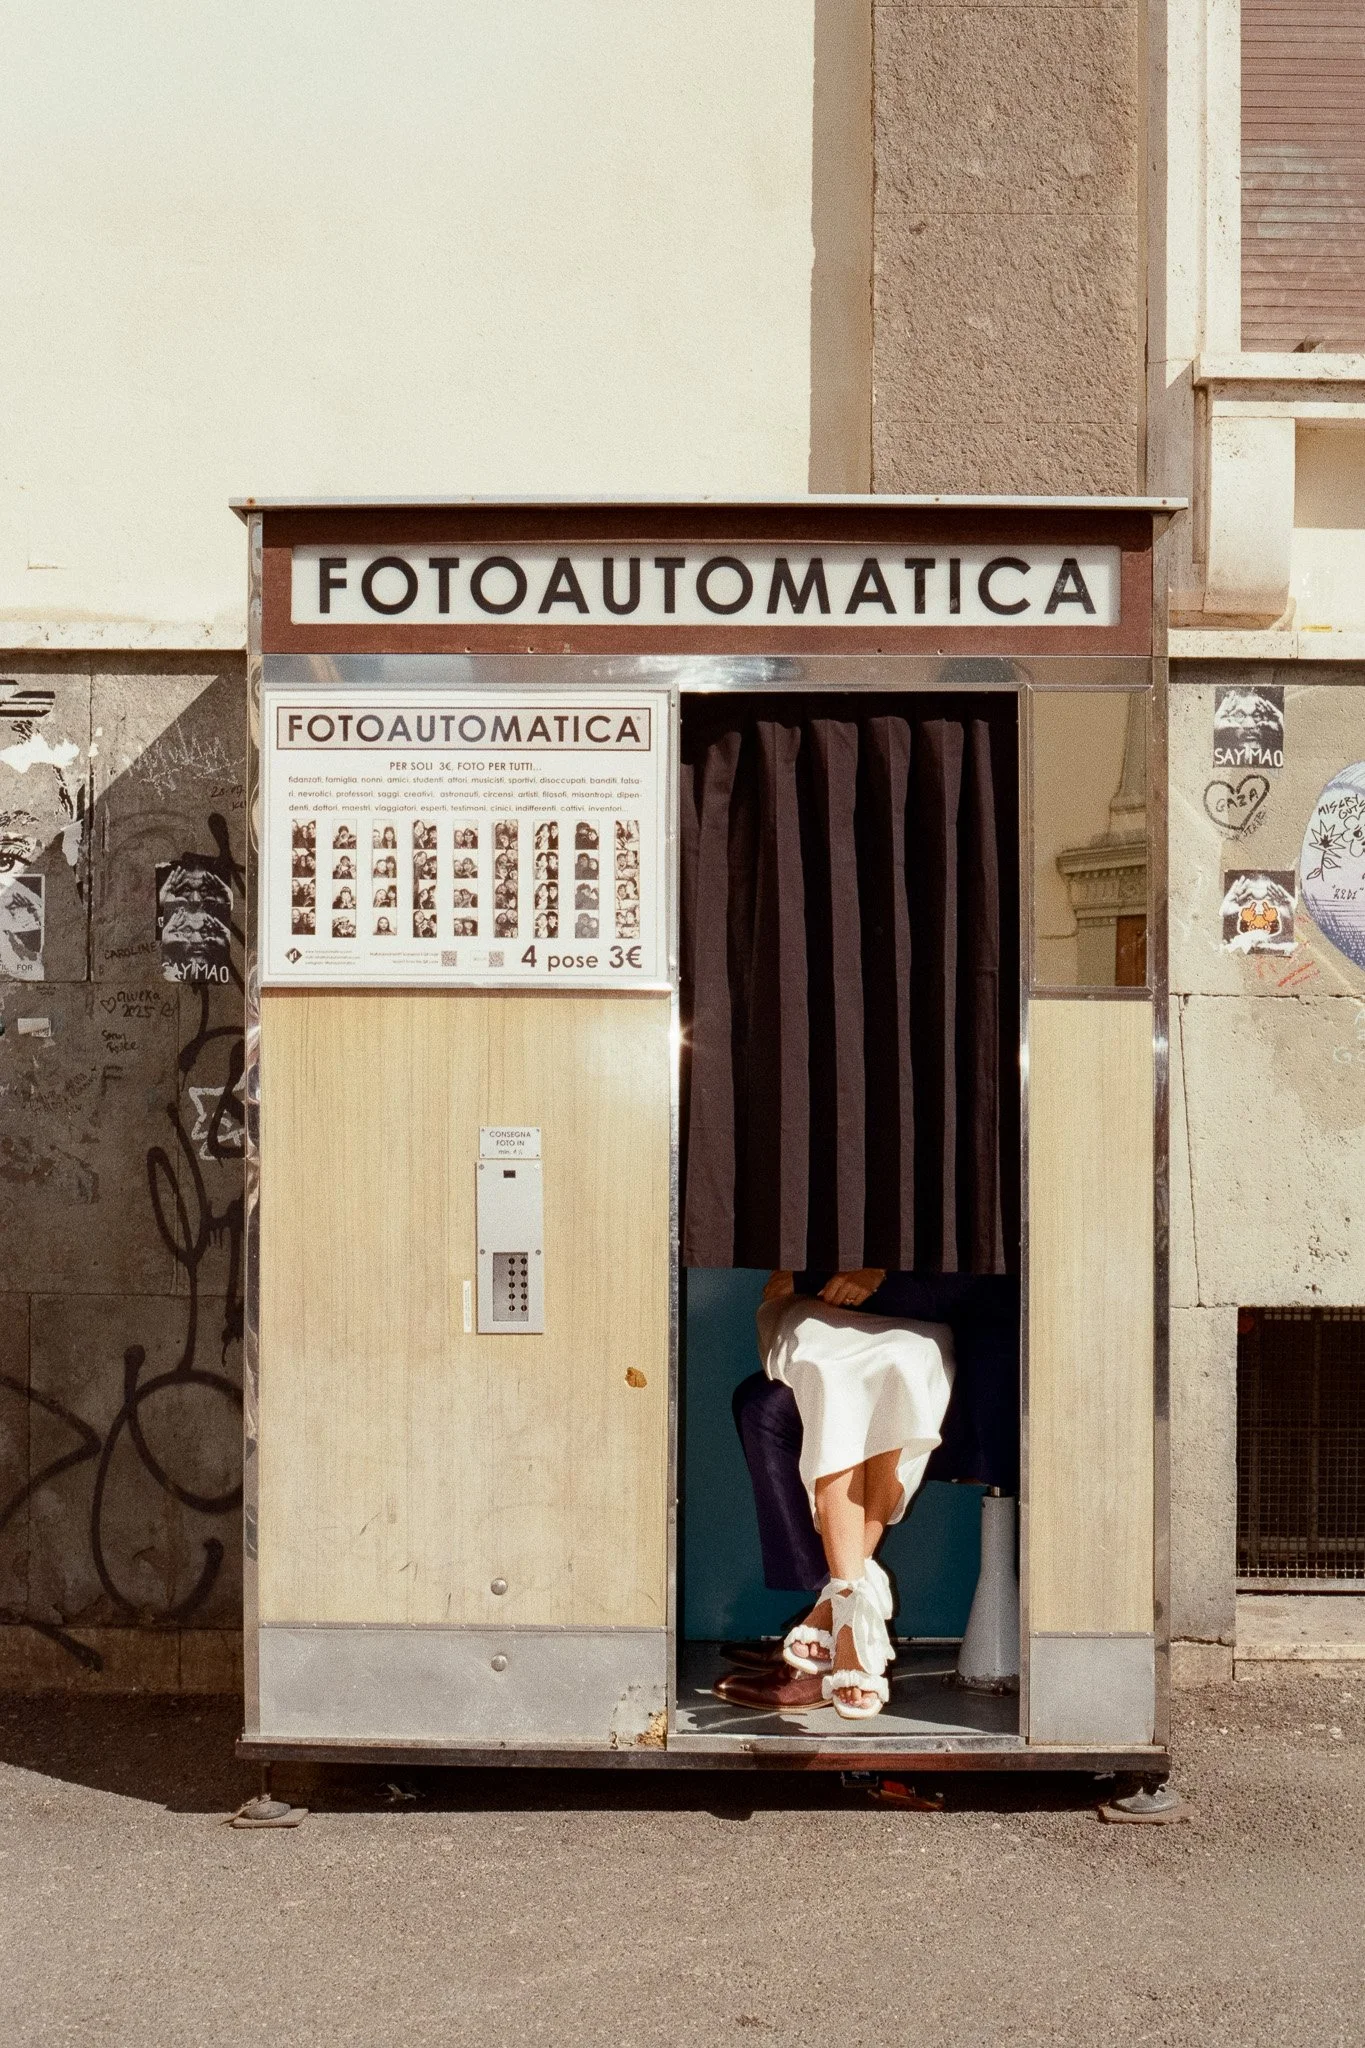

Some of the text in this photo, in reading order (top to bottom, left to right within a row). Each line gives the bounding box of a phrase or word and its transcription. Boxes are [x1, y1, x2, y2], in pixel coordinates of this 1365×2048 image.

[319, 556, 1097, 615] FOTOAUTOMATICA
[288, 714, 642, 744] FOTOAUTOMATICA
[389, 762, 408, 771] PER
[410, 762, 433, 771] SOLI
[457, 762, 485, 771] FOTO
[488, 762, 506, 771] PER
[1214, 747, 1284, 767] SAY MAO
[1215, 787, 1259, 812] GAZA
[104, 942, 157, 960] CAROLINE
[521, 945, 643, 972] 4 pose 3€
[195, 963, 229, 983] MAO
